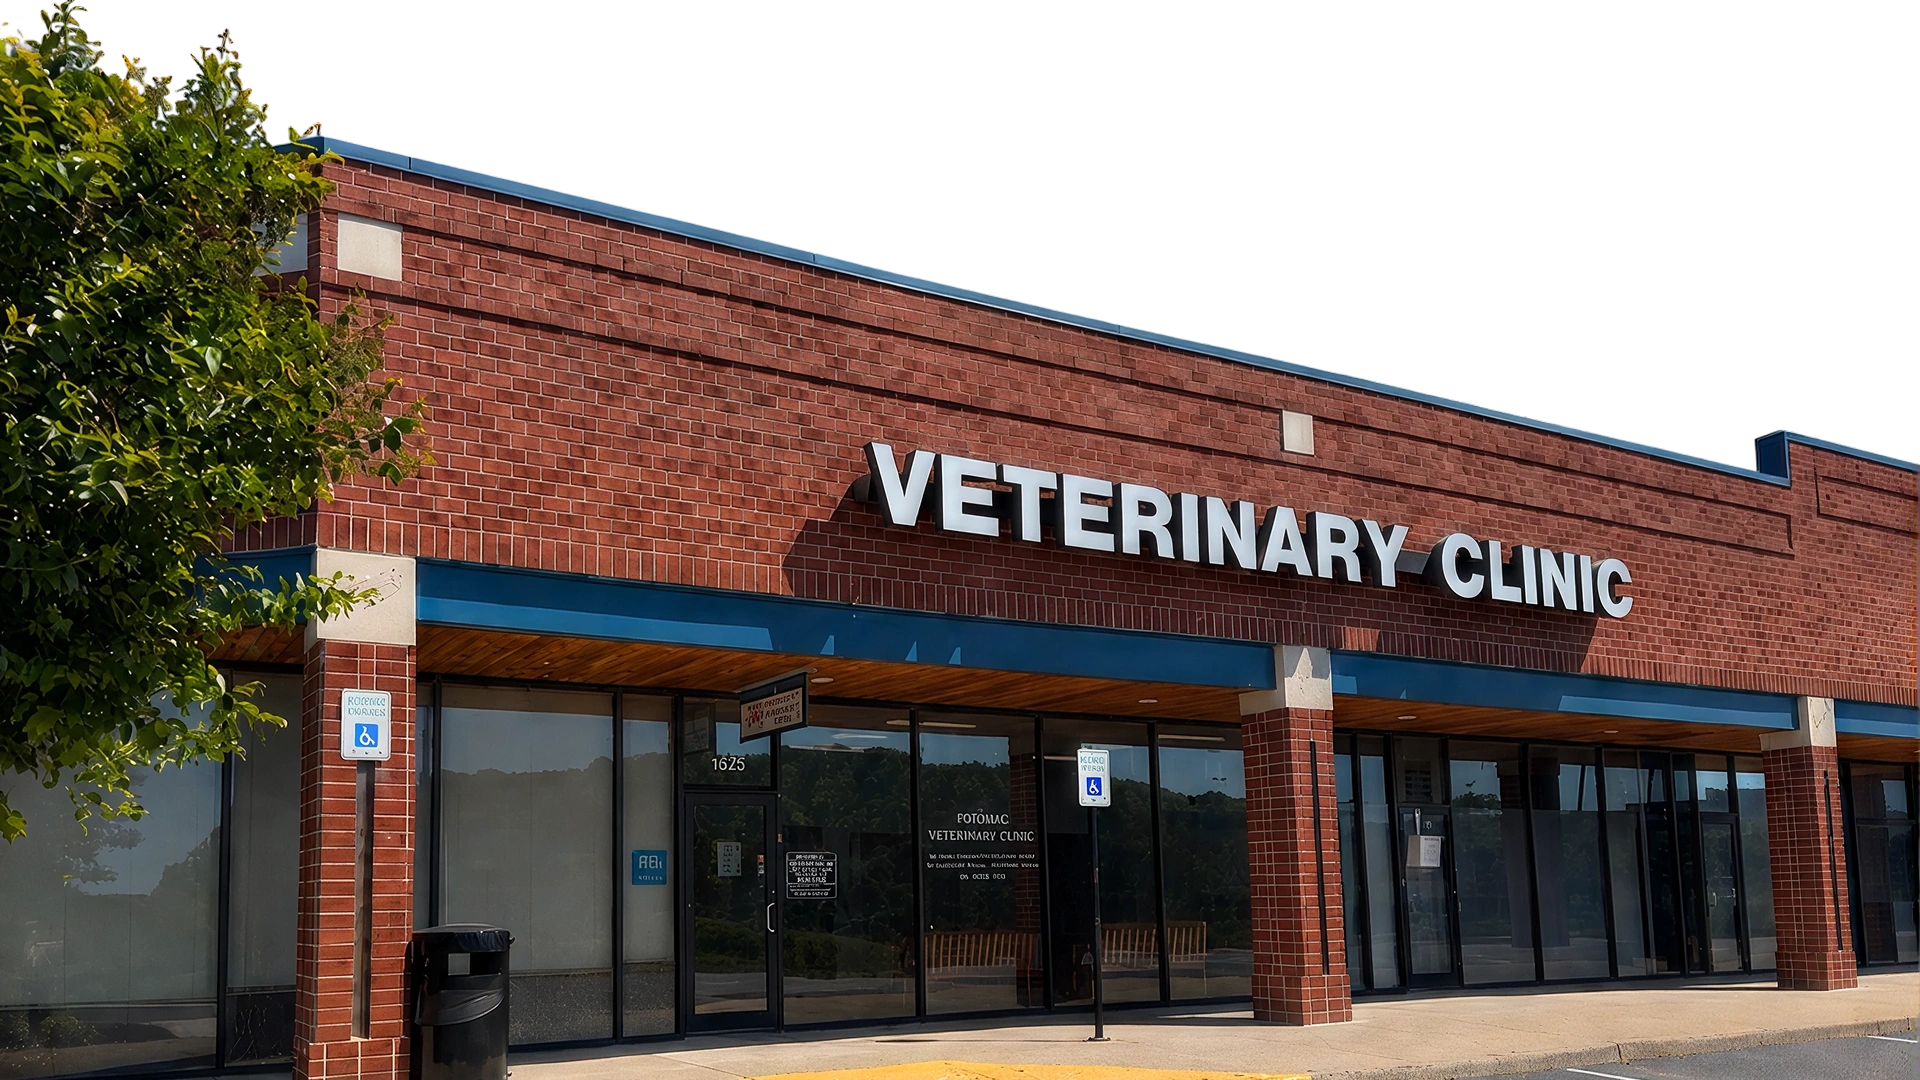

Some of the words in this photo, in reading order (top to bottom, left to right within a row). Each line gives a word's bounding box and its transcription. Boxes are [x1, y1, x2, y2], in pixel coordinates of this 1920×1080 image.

[863, 441, 1410, 588] VETERINARY
[1436, 532, 1634, 619] CLINIC
[711, 756, 746, 772] 1625
[928, 830, 997, 842] VETERINARY
[1000, 830, 1035, 842] CLINIC
